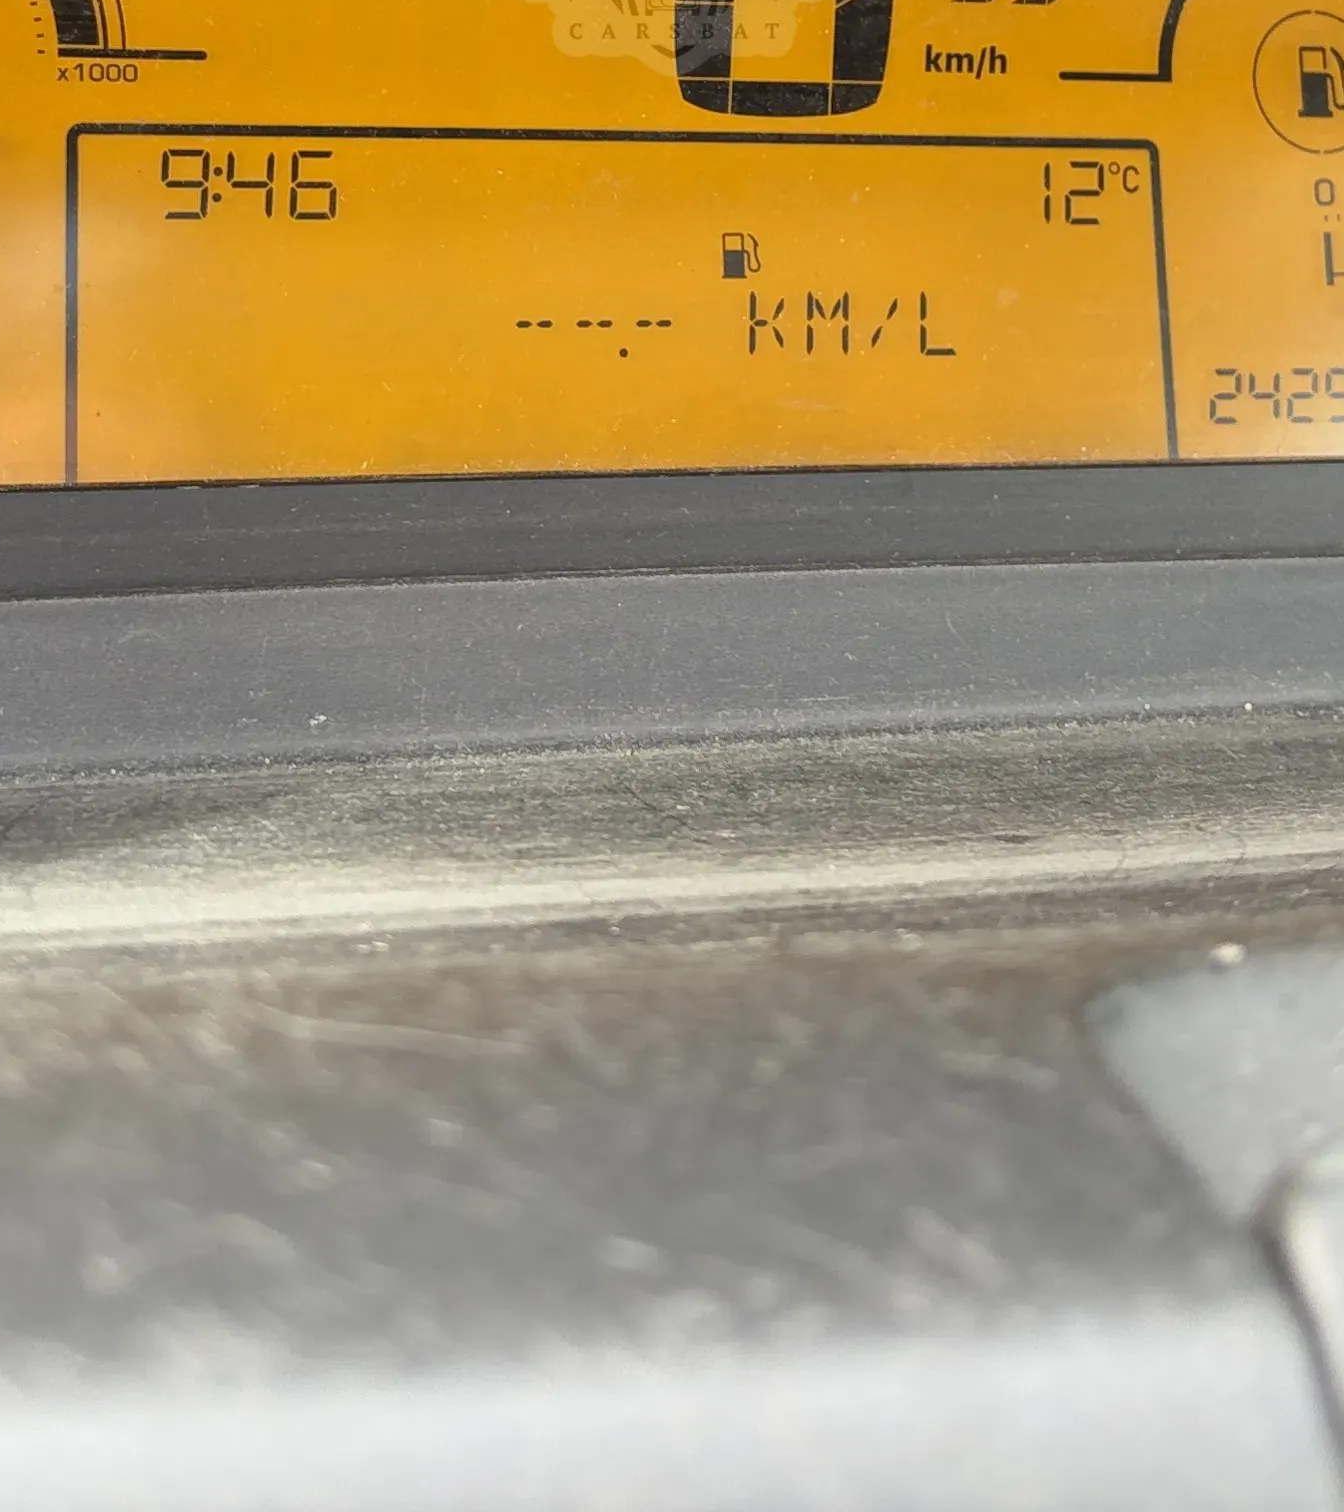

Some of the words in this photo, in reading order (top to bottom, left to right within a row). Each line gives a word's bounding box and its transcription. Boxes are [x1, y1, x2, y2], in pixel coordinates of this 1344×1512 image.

[57, 62, 138, 83] x1000
[925, 44, 1008, 80] km/h
[161, 148, 339, 221] 9:46
[1314, 178, 1336, 206] 0
[748, 290, 957, 357] KM/L
